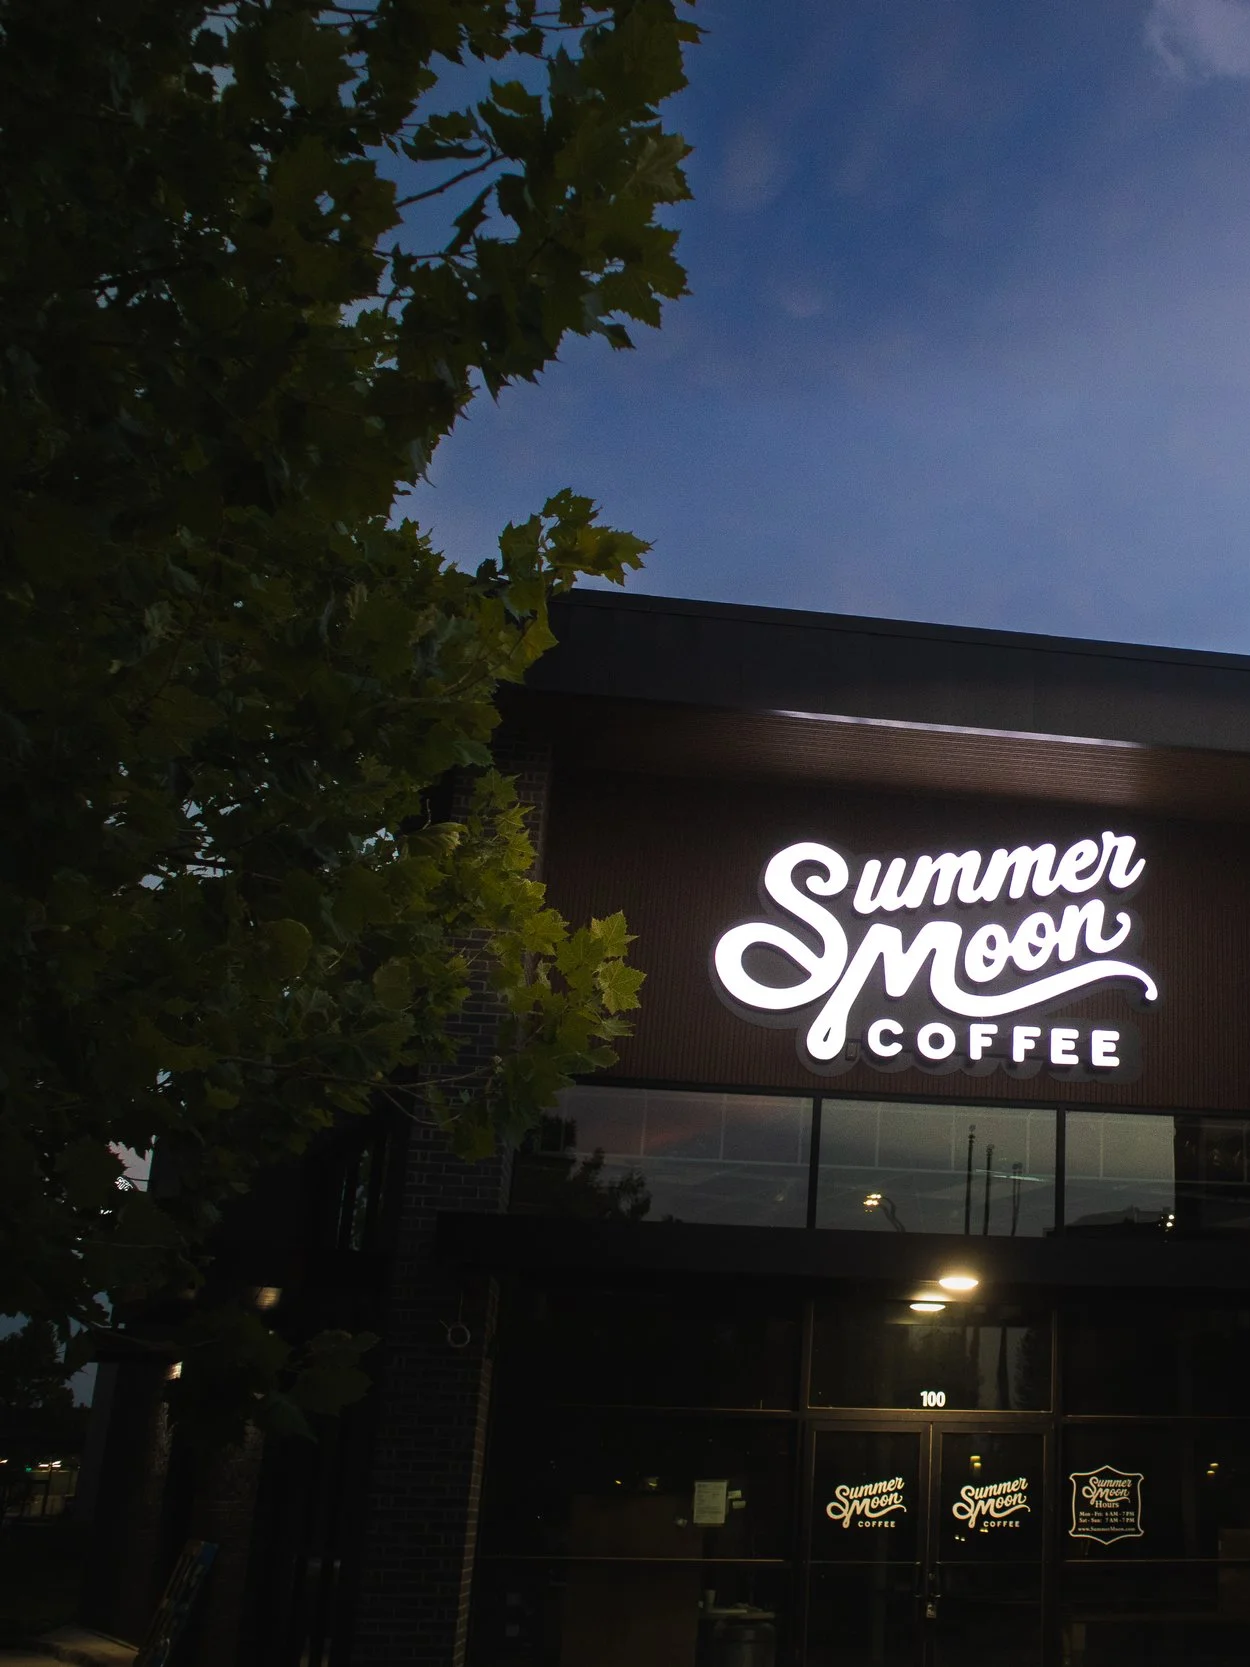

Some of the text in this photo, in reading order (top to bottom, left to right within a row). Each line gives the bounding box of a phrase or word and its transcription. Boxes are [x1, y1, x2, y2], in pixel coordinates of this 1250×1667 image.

[715, 831, 1146, 1010] Summer
[806, 898, 1158, 1061] Moon
[867, 1019, 1120, 1067] COFFEE
[920, 1391, 946, 1407] 100
[826, 1477, 905, 1520] Summer
[952, 1477, 1029, 1520] Summer
[1082, 1476, 1133, 1498] Summer
[1090, 1488, 1131, 1506] Moon
[1095, 1500, 1120, 1508] Hours
[842, 1492, 907, 1528] Moon
[857, 1520, 896, 1528] COFFEE
[968, 1492, 1031, 1528] Moon
[983, 1520, 1021, 1528] COFFEE
